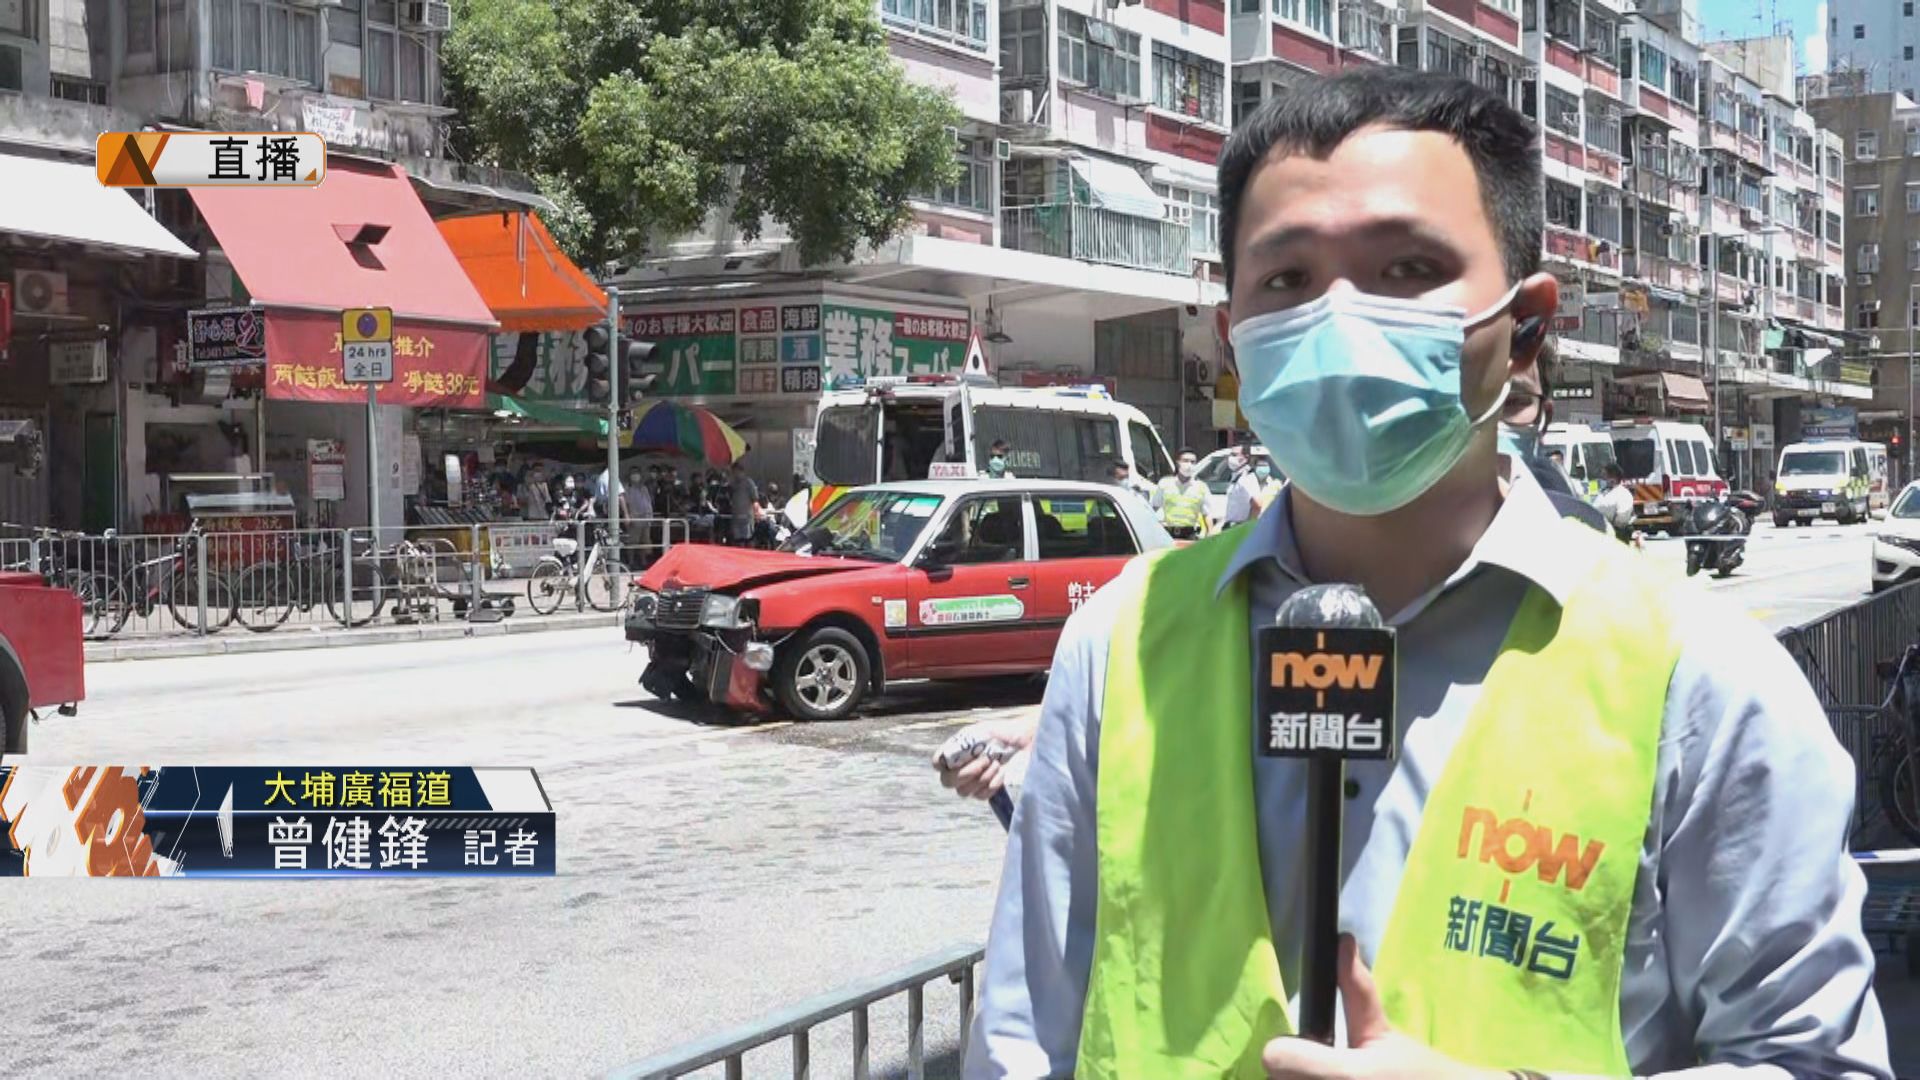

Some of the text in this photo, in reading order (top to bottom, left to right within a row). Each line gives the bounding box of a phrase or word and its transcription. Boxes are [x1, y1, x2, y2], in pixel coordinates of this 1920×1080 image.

[743, 310, 775, 331] 食品
[784, 306, 819, 330] 海鮮
[348, 346, 387, 358] 24 hrs
[742, 339, 776, 362] 青果
[825, 310, 893, 385] 業務
[353, 362, 383, 377] 全日
[784, 369, 819, 391] 精肉
[932, 465, 966, 477] TAXI
[1068, 582, 1095, 597] 的士
[1068, 598, 1089, 613] TA
[1270, 651, 1383, 689] now
[1269, 712, 1383, 750] 新聞台
[1457, 806, 1605, 891] now
[1444, 895, 1580, 980] 新聞台
